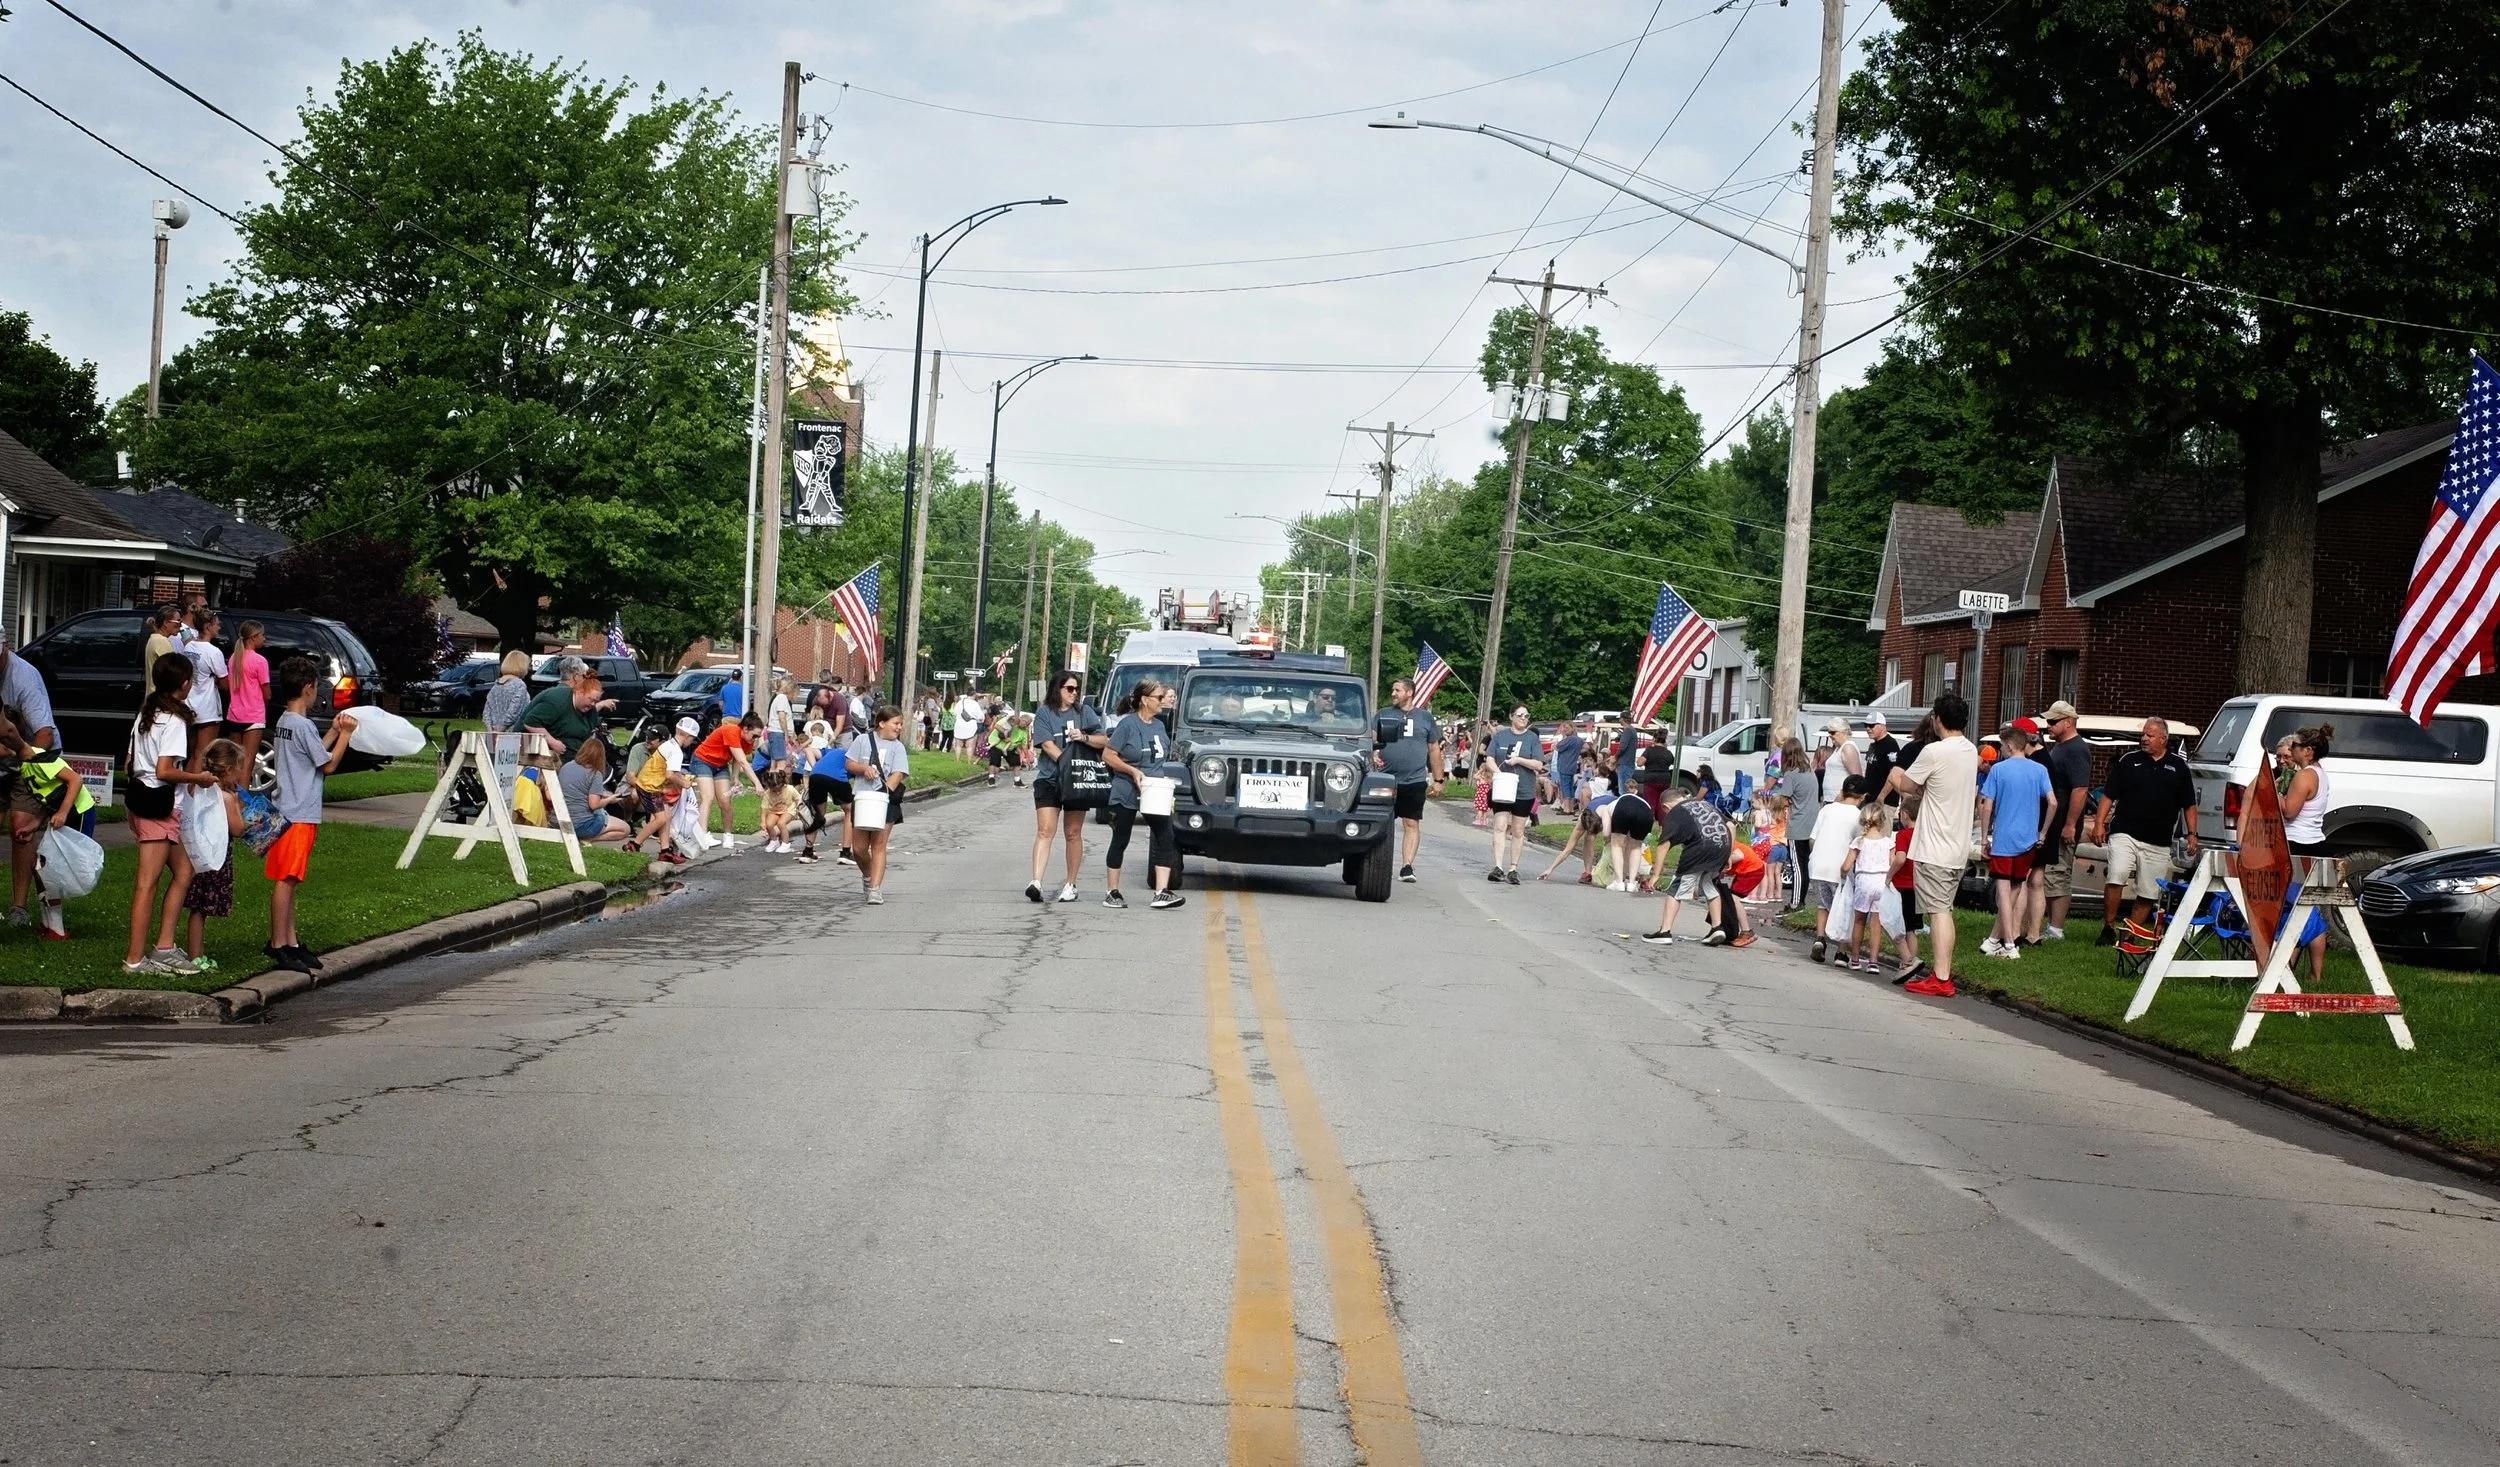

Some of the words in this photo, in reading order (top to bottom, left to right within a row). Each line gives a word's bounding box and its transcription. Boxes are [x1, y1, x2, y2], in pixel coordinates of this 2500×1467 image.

[797, 422, 842, 433] Frontenac
[796, 513, 838, 525] Raiders
[1963, 593, 2005, 610] LABETTE
[1246, 778, 1303, 788] FRONTENAC
[2249, 818, 2280, 849] STREET
[2246, 869, 2281, 901] CLOSED
